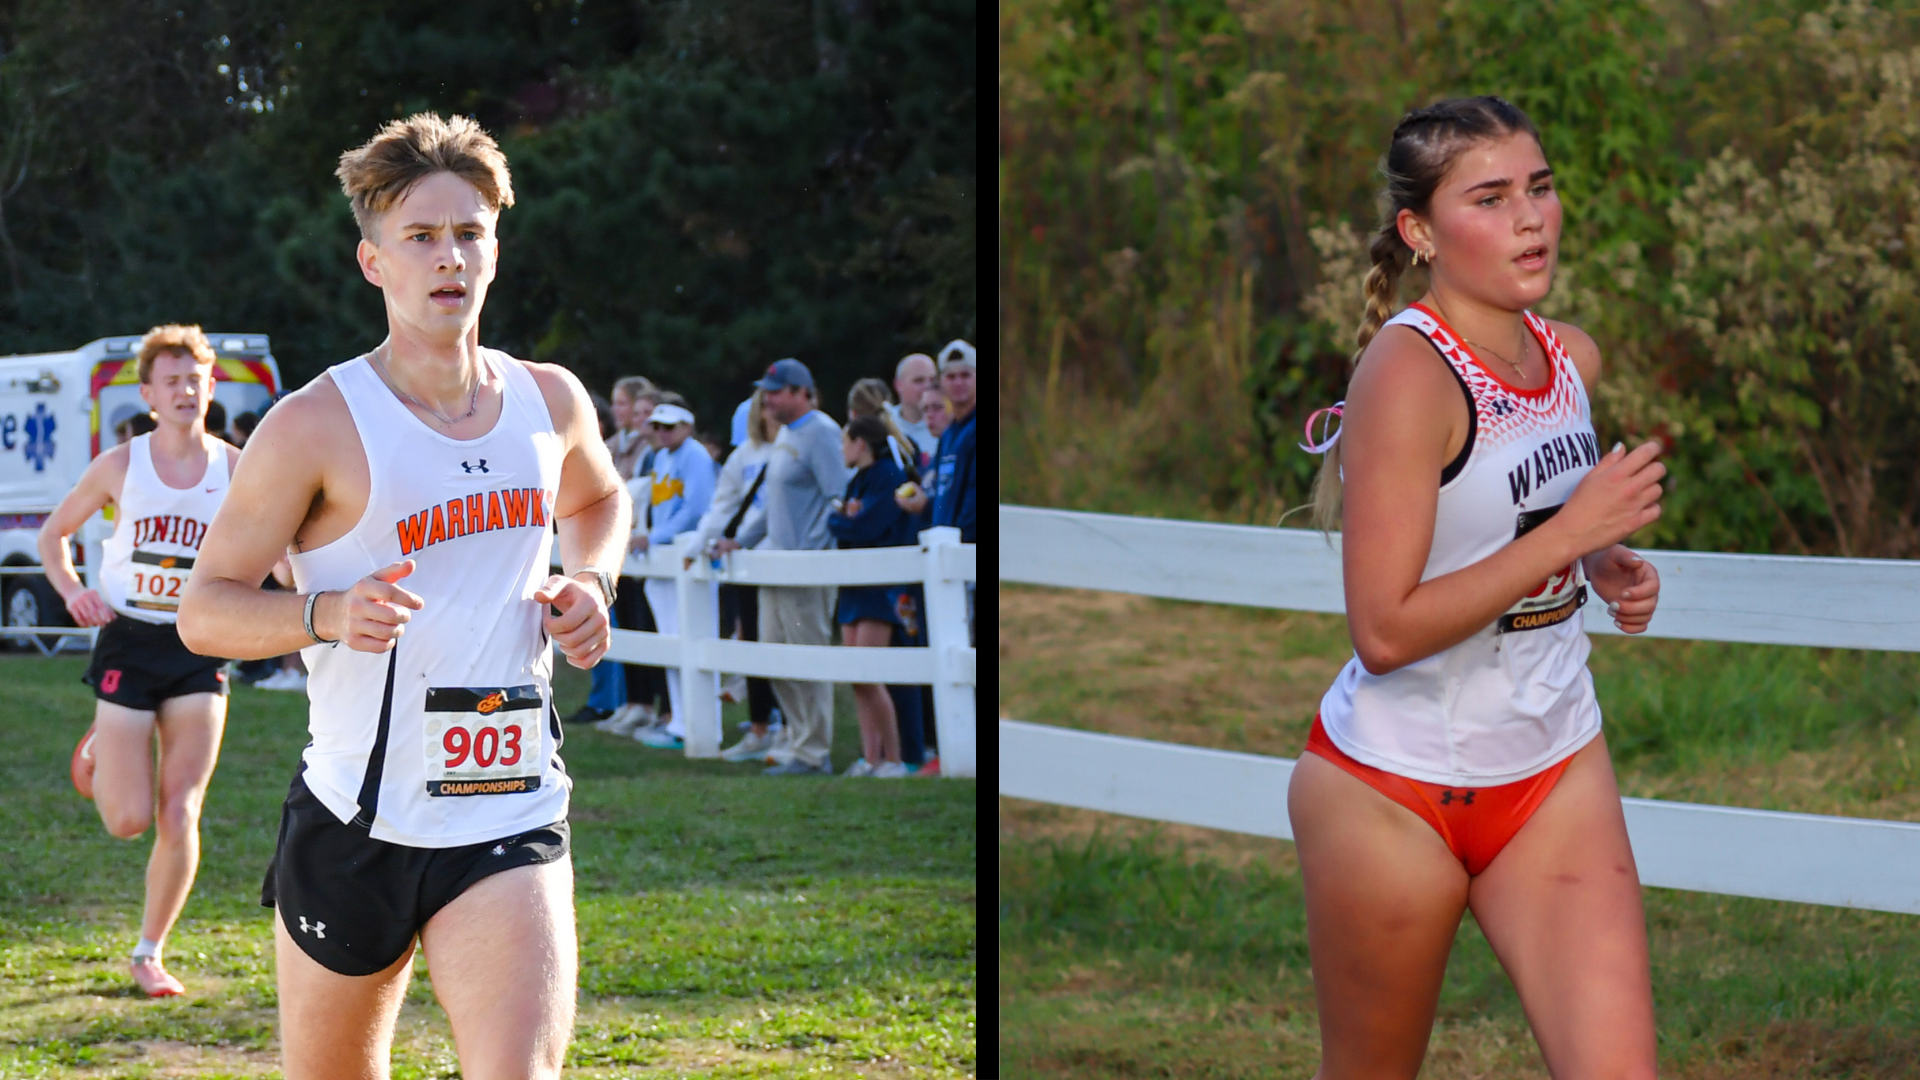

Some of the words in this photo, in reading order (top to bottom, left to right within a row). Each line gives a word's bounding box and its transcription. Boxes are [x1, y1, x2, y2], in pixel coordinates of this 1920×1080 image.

[135, 572, 189, 597] 102
[443, 724, 522, 768] 903
[440, 780, 526, 794] CHAMPIONSHIPS
